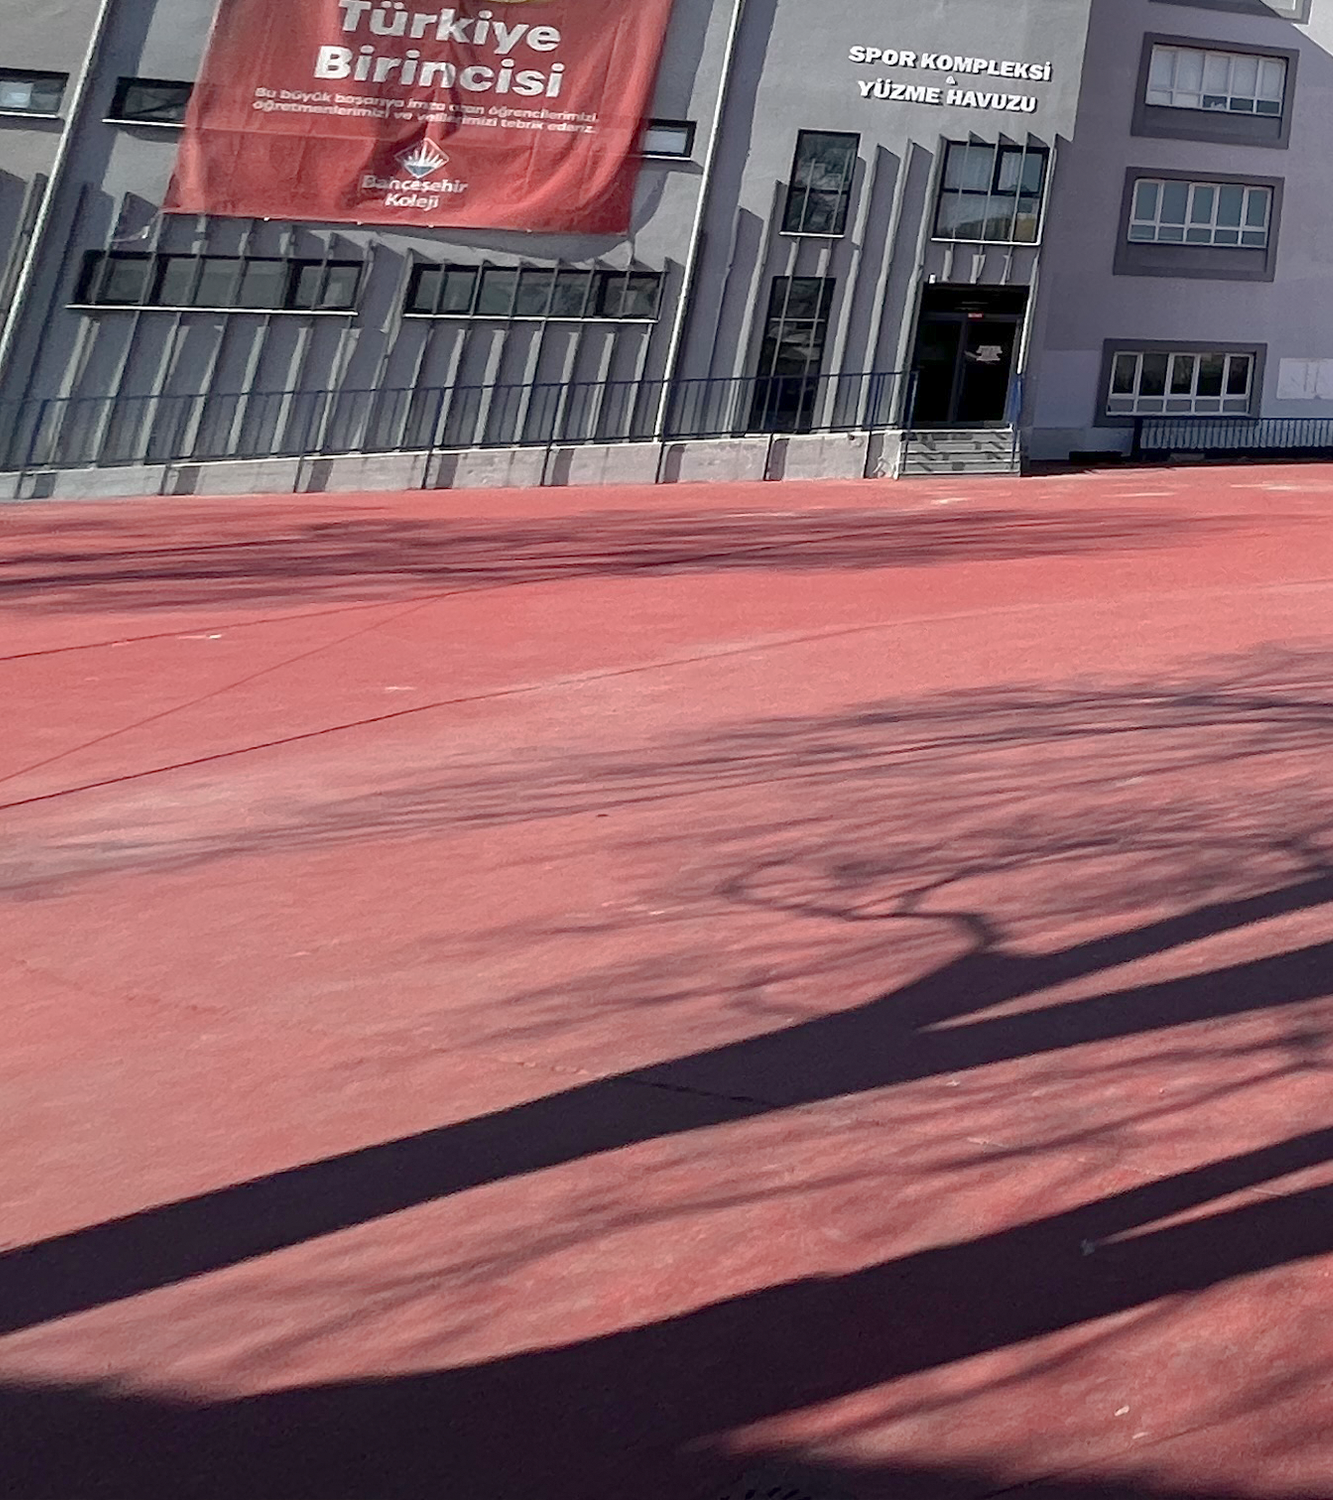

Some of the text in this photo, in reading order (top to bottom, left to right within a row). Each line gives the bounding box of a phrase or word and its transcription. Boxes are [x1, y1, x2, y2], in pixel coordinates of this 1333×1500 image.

[338, 0, 562, 55] Türkiye
[313, 44, 566, 98] Birincisi
[848, 45, 1053, 82] SPOR KOMPLEKSİ
[857, 77, 1037, 113] YÜZME HAVUZU
